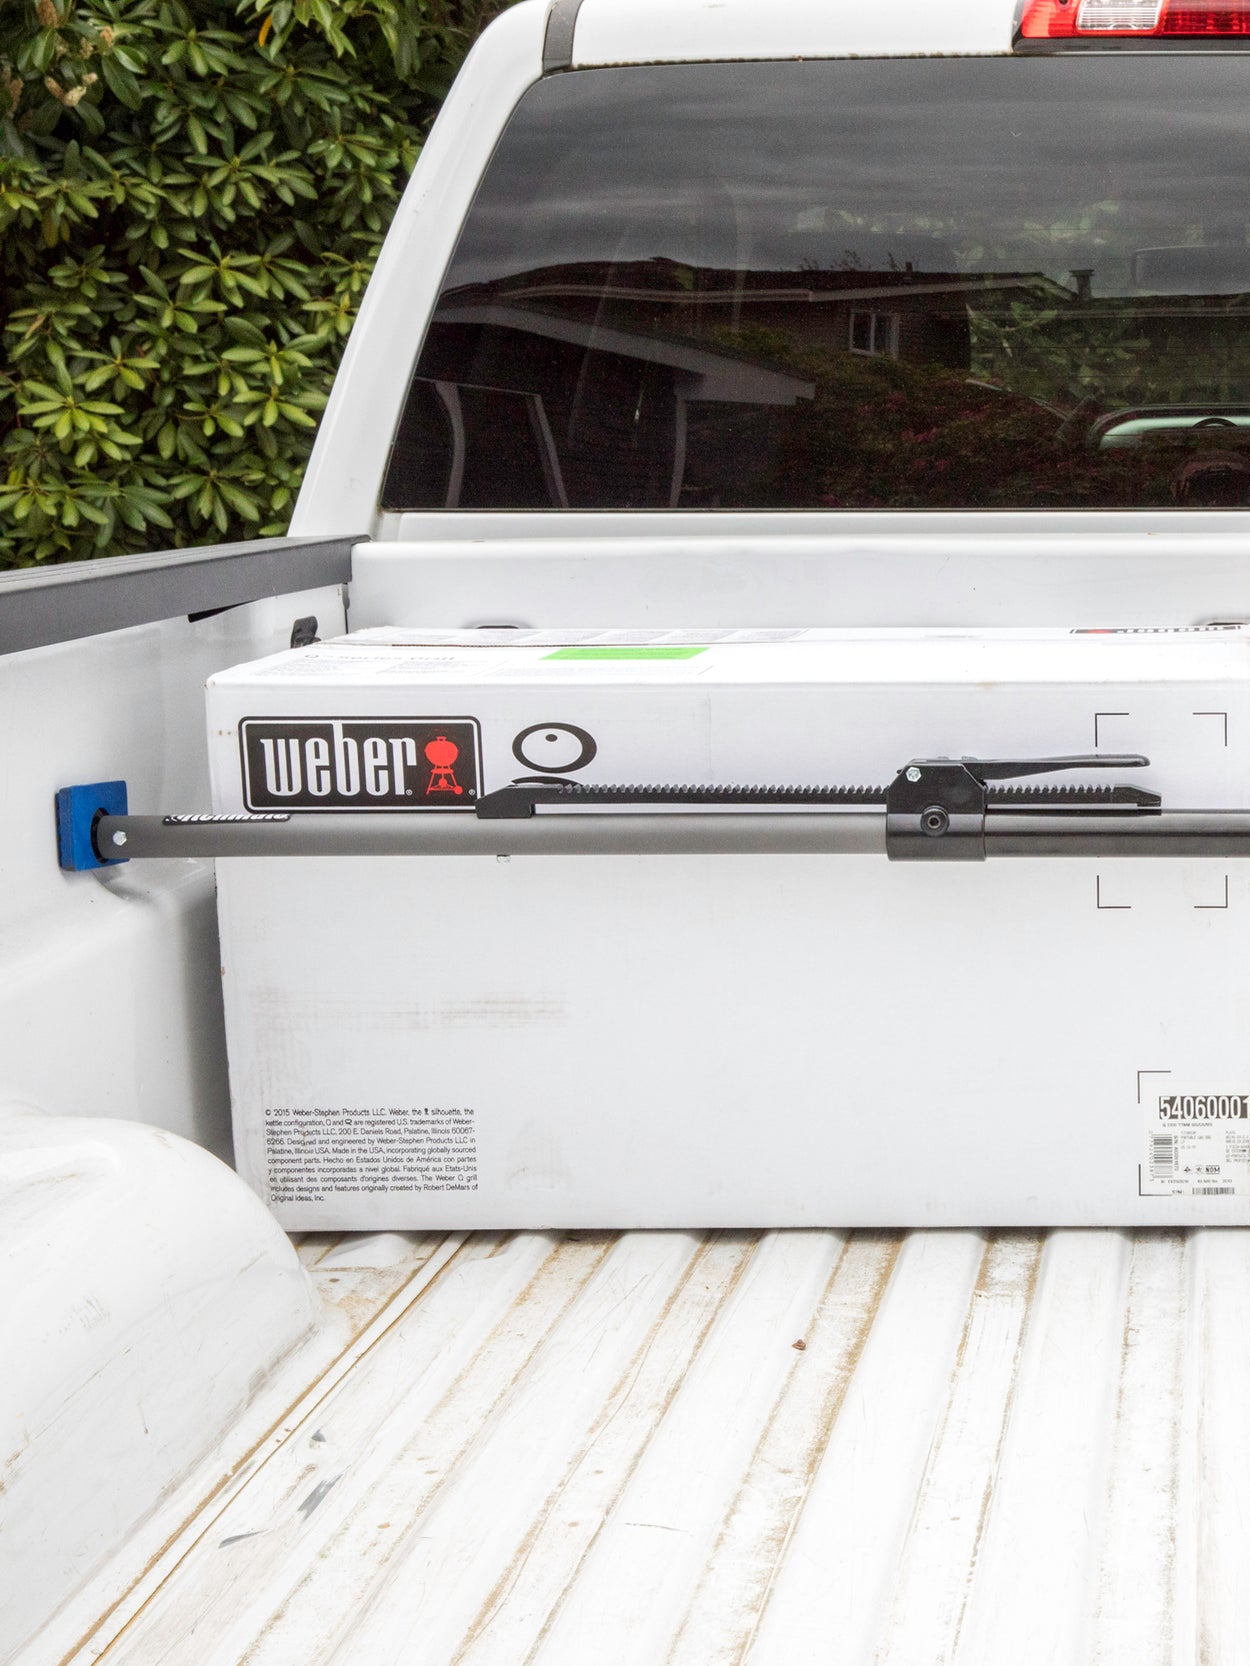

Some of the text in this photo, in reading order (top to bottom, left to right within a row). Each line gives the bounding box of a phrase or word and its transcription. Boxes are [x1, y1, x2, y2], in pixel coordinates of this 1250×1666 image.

[260, 721, 417, 796] weber
[292, 1109, 340, 1118] Weber-Stephen
[283, 1119, 325, 1128] configuration,
[364, 1118, 396, 1127] registered
[266, 1128, 292, 1137] Stephen
[287, 1138, 316, 1146] Designed
[331, 1137, 366, 1146] engineered
[368, 1137, 375, 1146] by
[376, 1137, 424, 1146] Weber-Stephen
[386, 1146, 426, 1155] incorporating
[427, 1146, 450, 1155] globally
[267, 1156, 302, 1165] component
[456, 1156, 477, 1164] partes
[273, 1166, 315, 1174] componentes
[320, 1175, 358, 1184] composants
[466, 1174, 478, 1183] grill
[296, 1184, 320, 1193] designs
[361, 1184, 388, 1193] originally
[414, 1184, 422, 1192] by
[271, 1194, 294, 1203] Original
